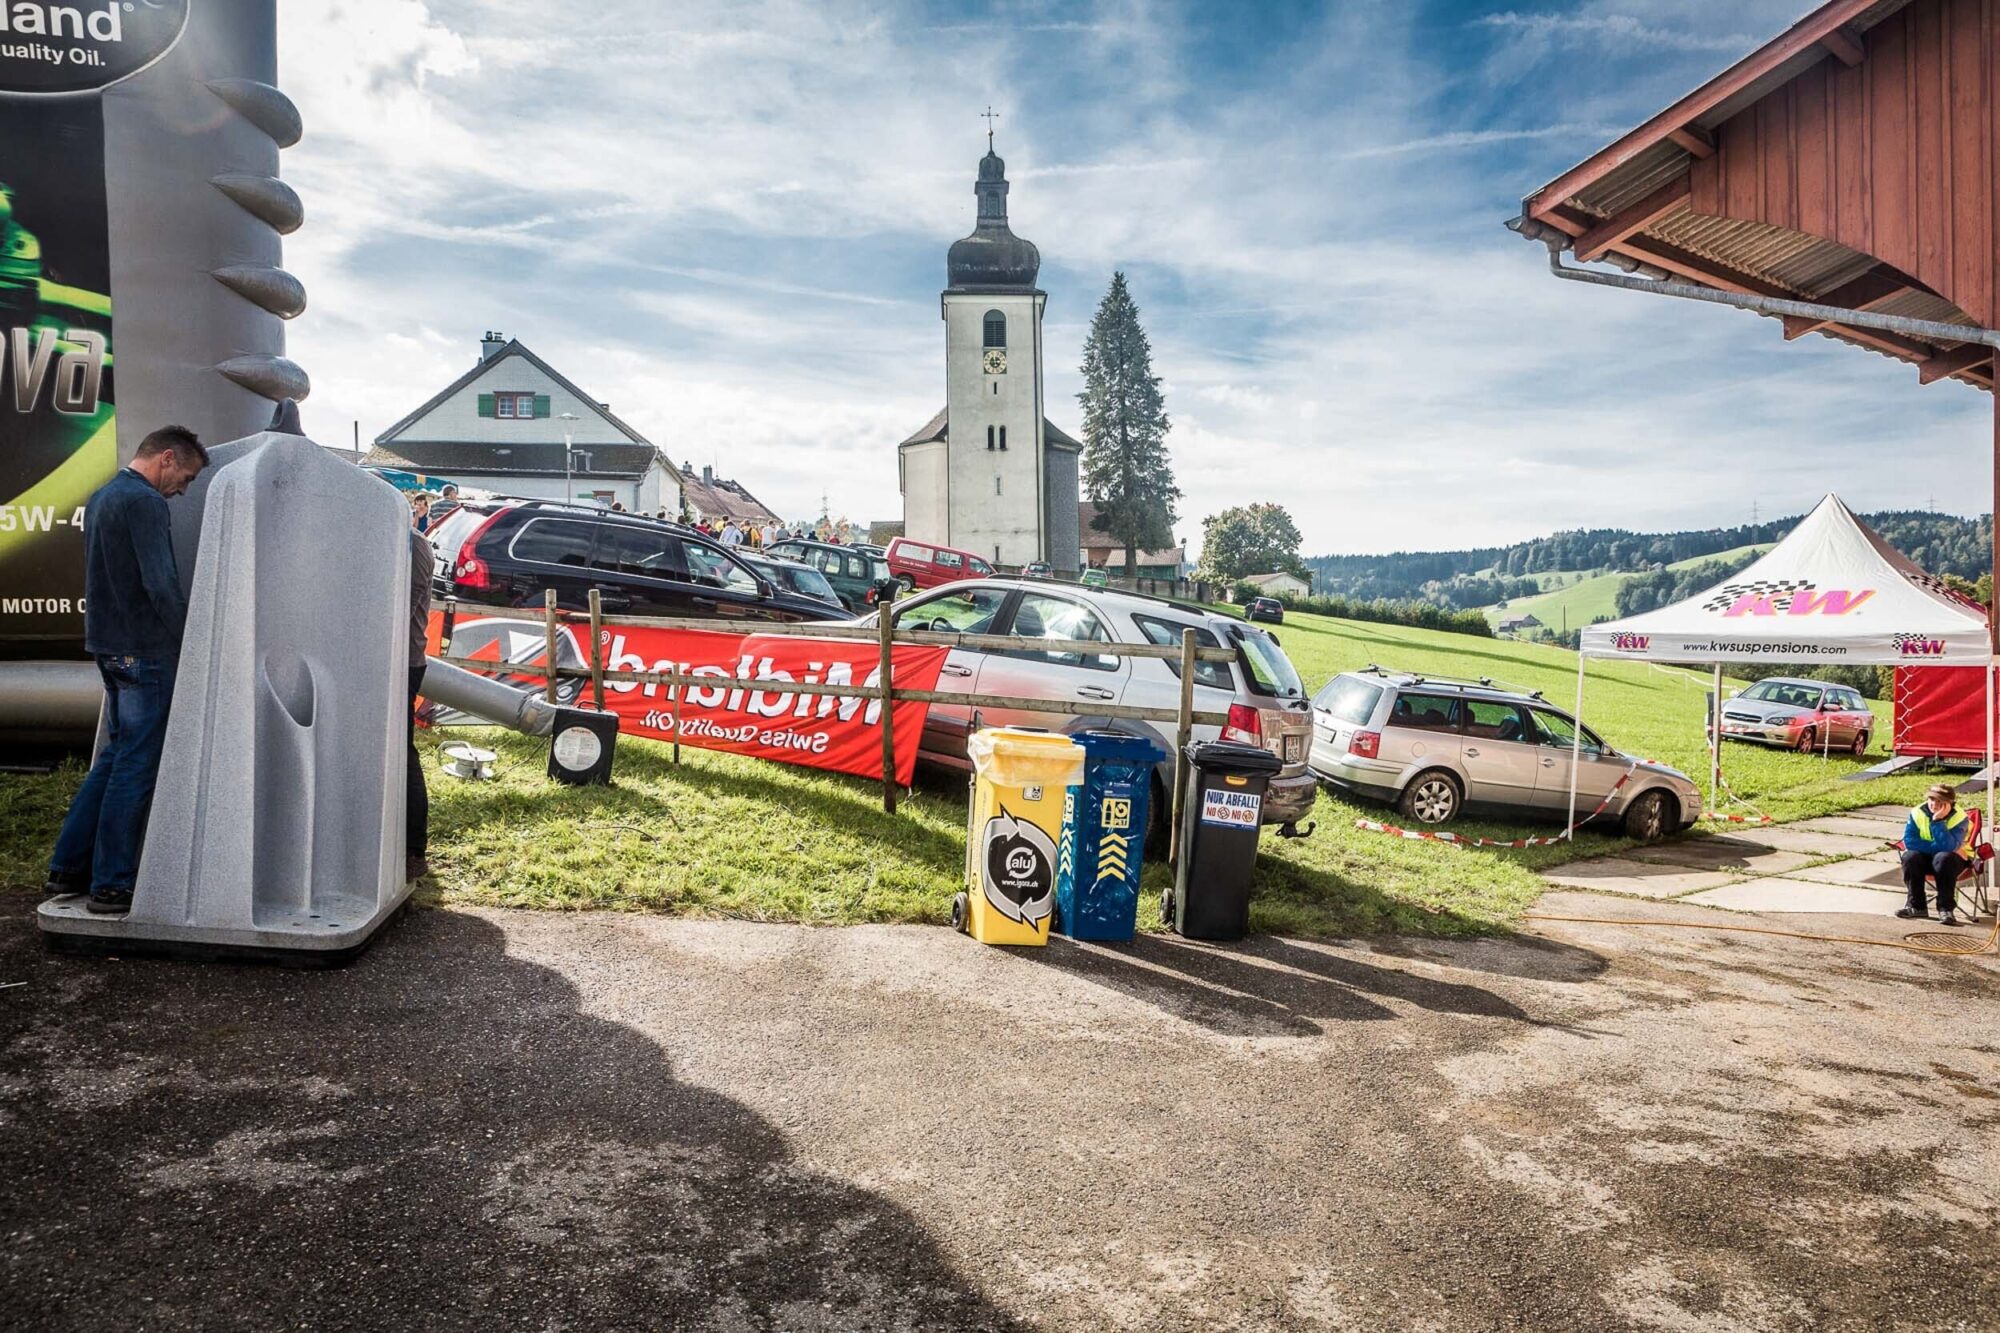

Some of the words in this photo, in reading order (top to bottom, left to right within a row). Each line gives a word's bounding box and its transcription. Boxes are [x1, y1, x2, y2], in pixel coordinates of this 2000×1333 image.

[0, 43, 64, 65] uality
[69, 48, 106, 66] Oil.
[0, 327, 106, 416] va
[2, 598, 71, 614] MOTOR
[1723, 589, 1877, 617] KW
[1616, 635, 1649, 649] KW
[1683, 641, 1847, 655] www.kwsuspensions.com
[1901, 639, 1946, 655] KW
[1206, 790, 1225, 805] NUR
[1225, 793, 1259, 809] ABFALL!
[1206, 806, 1217, 817] NO
[1231, 809, 1242, 820] NO
[1011, 856, 1031, 869] alu
